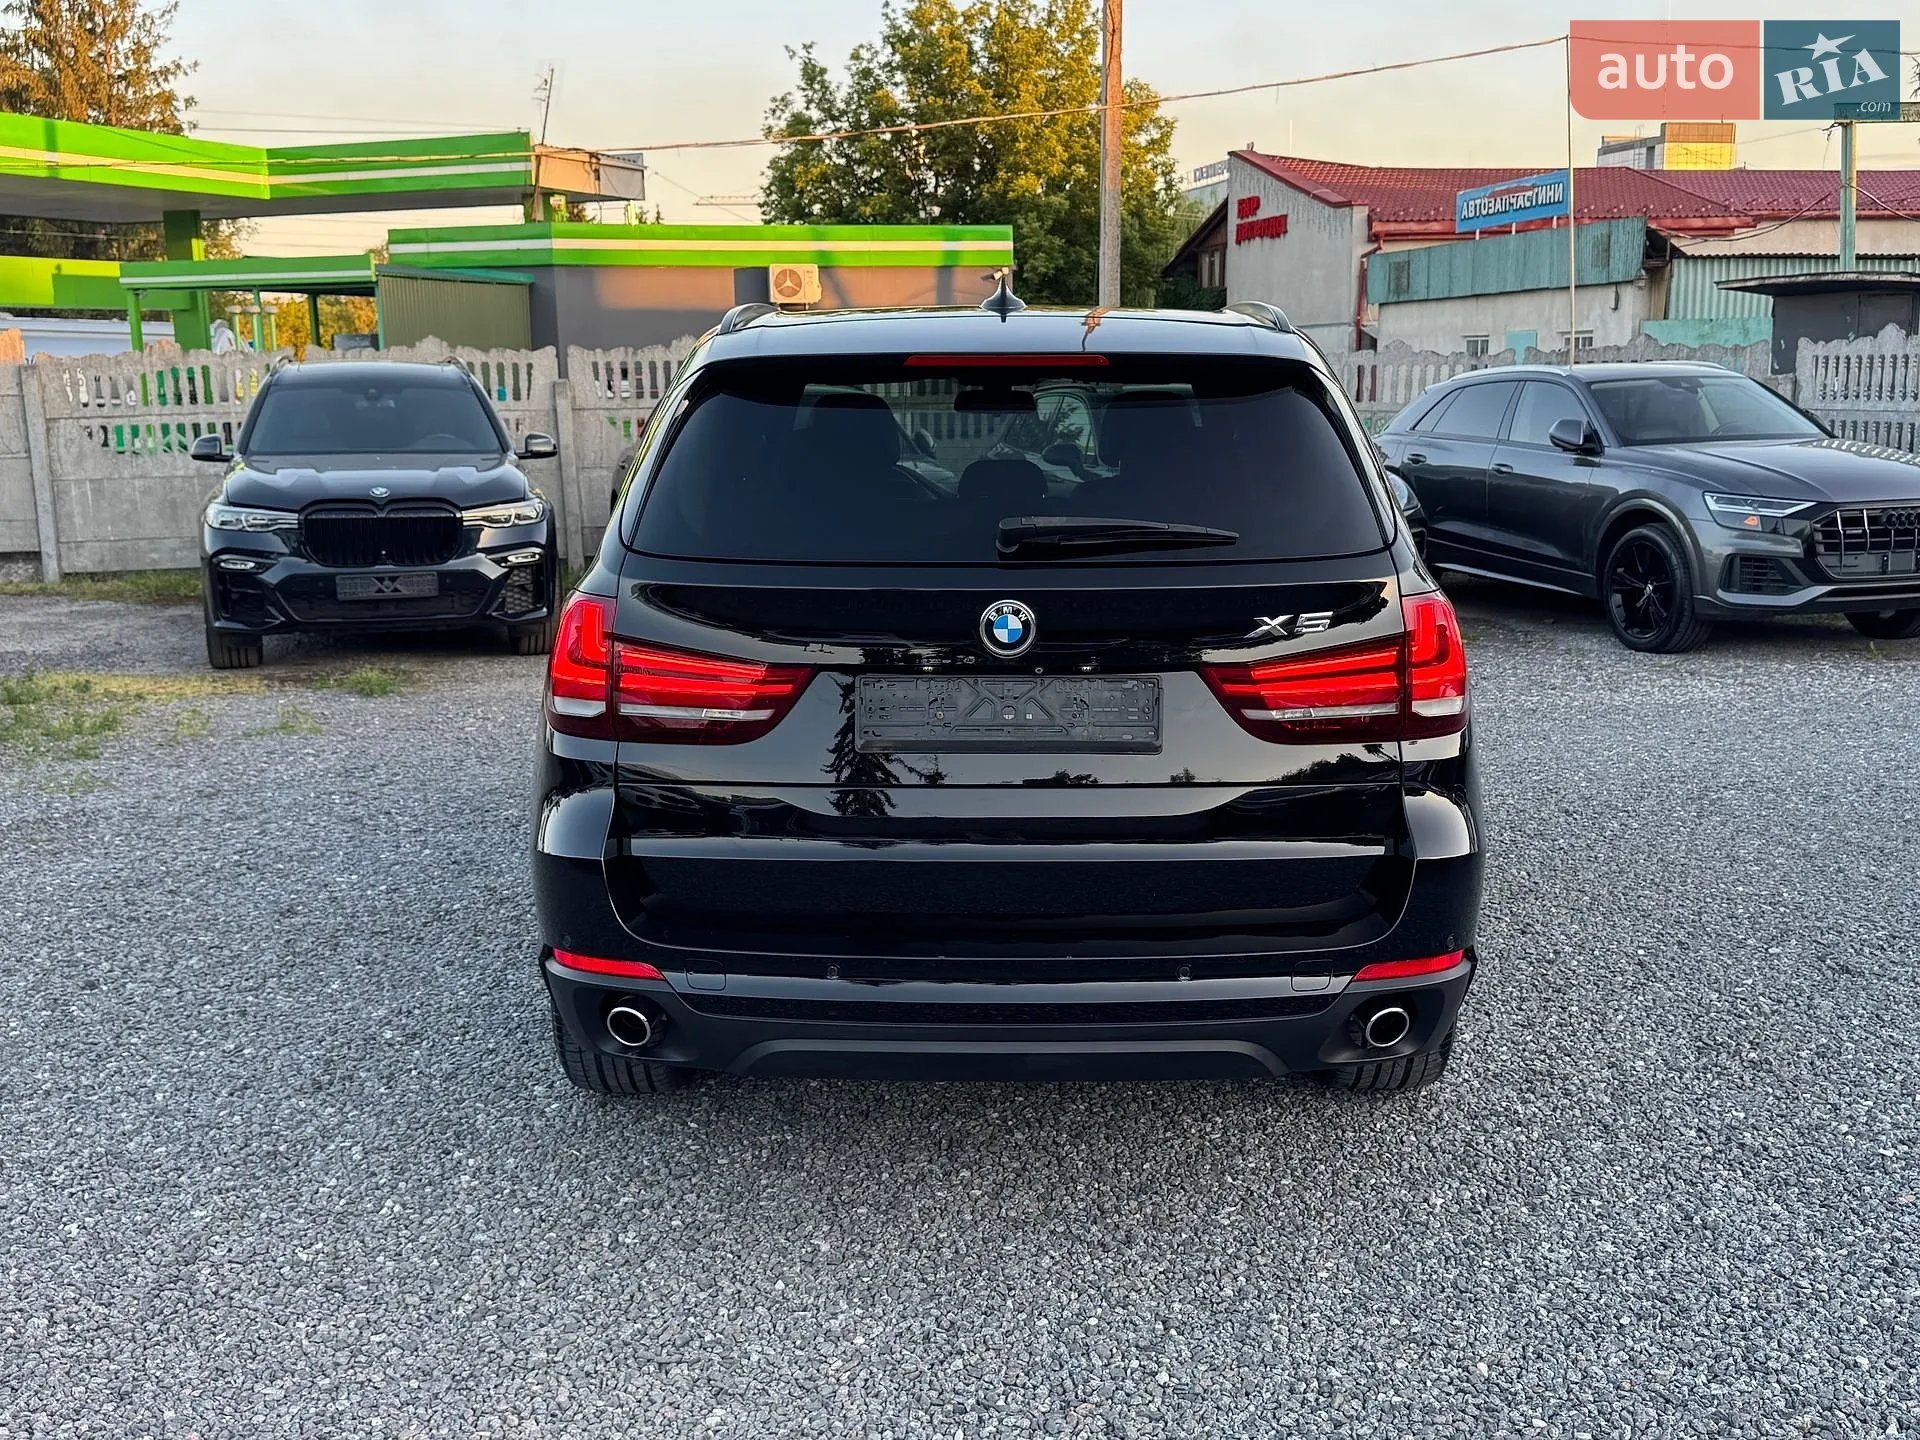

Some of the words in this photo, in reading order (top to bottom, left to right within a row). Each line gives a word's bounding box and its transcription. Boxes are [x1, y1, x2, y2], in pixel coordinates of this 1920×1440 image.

[1461, 182, 1564, 220] АВТОЗАПЧАСТИНИ
[988, 606, 1028, 622] BMW
[1243, 611, 1334, 638] X5
